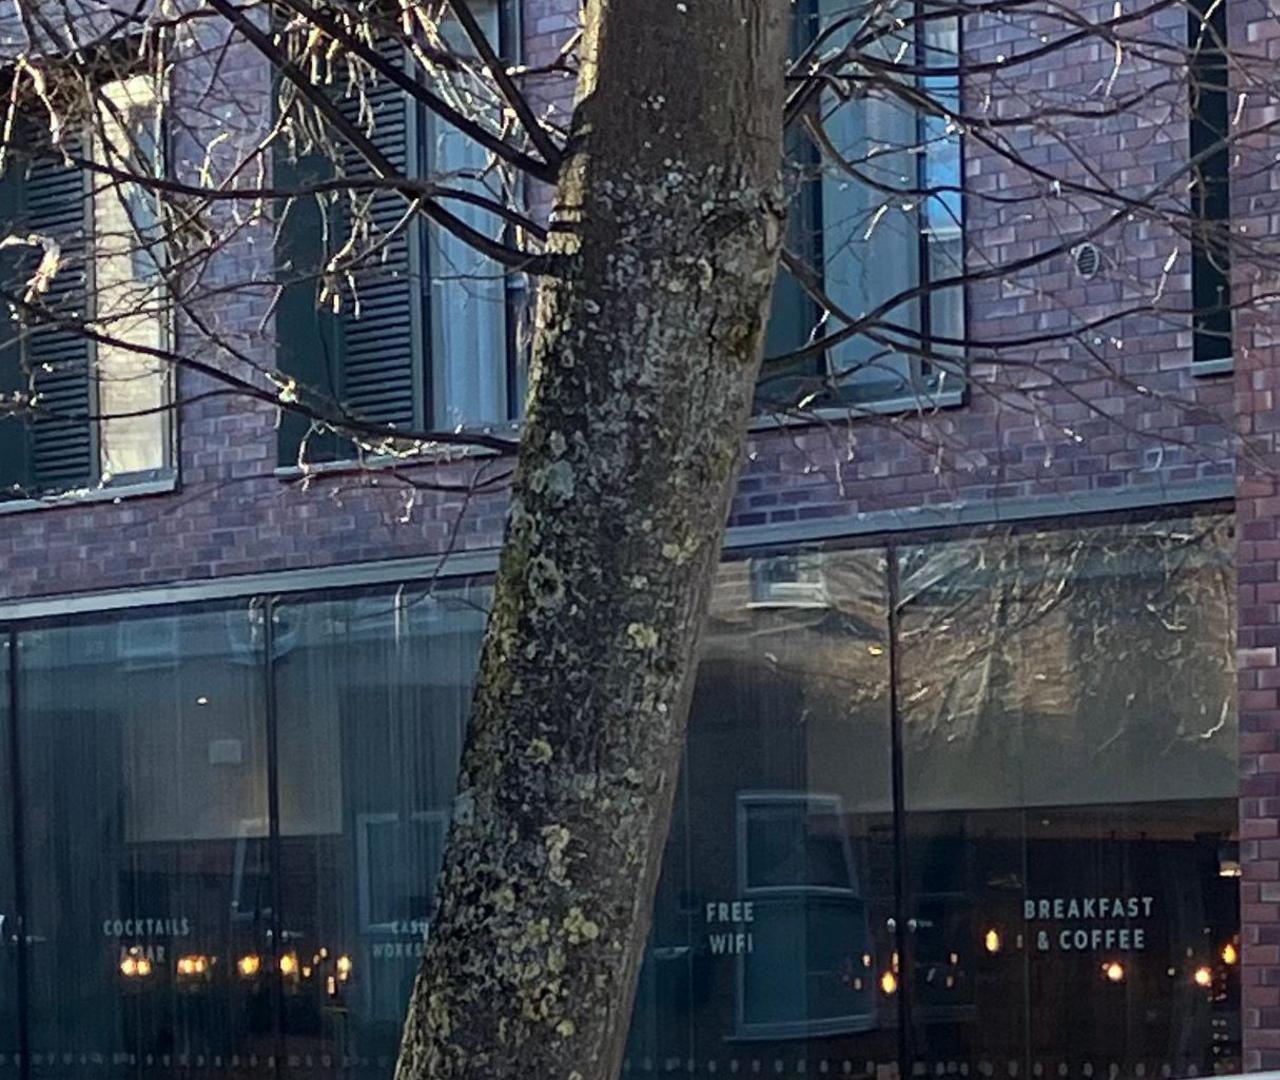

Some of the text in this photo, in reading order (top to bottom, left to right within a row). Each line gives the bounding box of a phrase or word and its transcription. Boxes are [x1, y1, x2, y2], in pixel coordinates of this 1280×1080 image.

[706, 901, 754, 923] FREE
[1024, 897, 1153, 919] BREAKFAST
[103, 918, 189, 936] COCKTAILS
[709, 933, 753, 954] WIFI
[1037, 929, 1145, 951] & COFFEE
